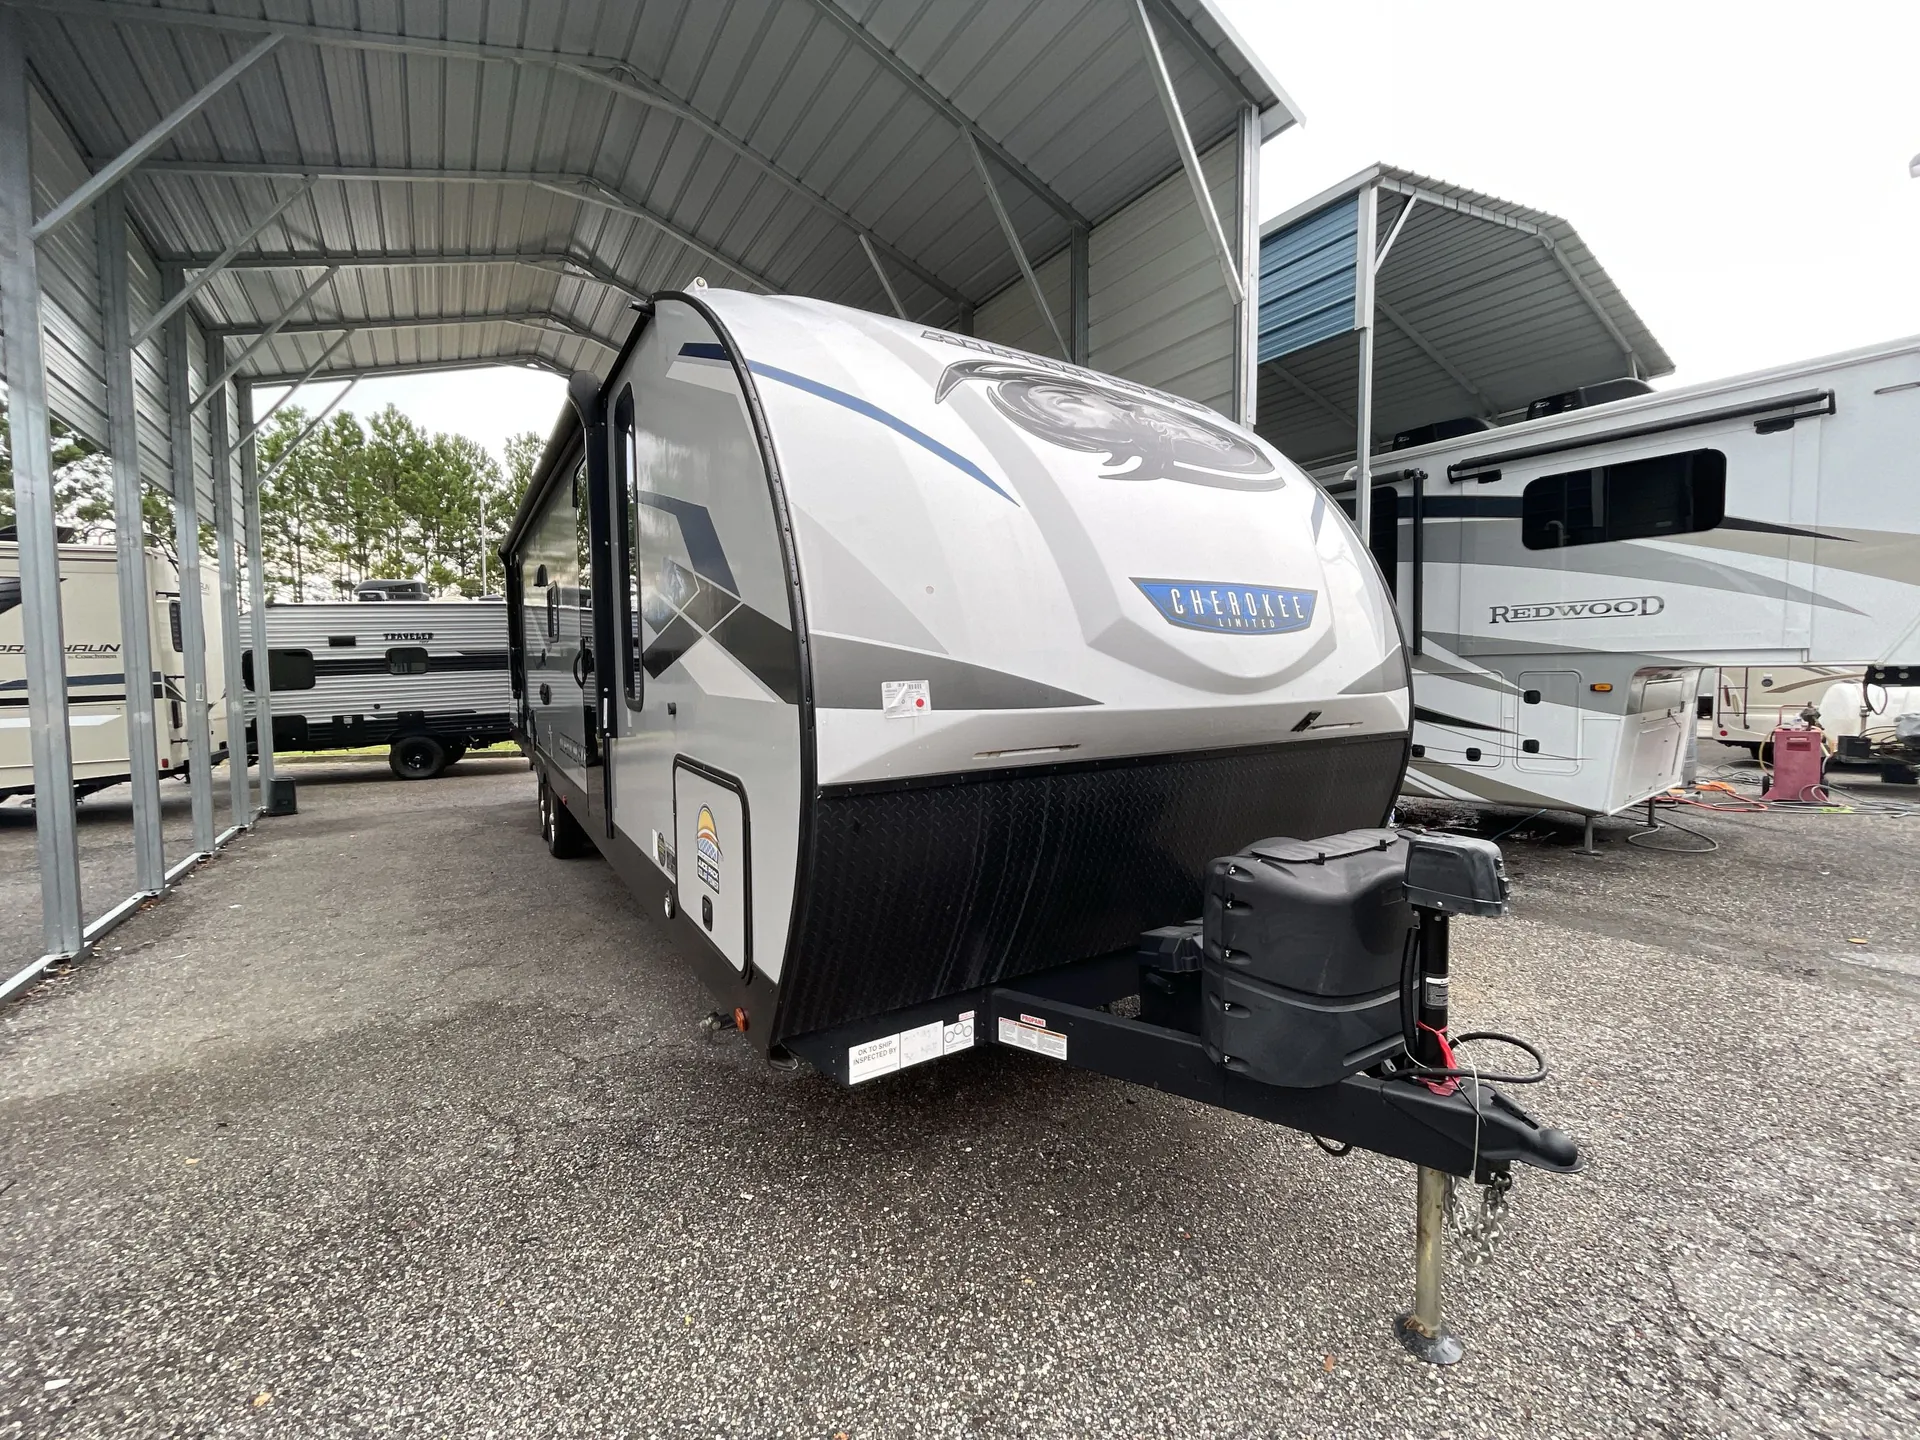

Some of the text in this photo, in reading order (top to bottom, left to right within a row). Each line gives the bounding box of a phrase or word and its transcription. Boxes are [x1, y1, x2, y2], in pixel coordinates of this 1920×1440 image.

[920, 330, 1100, 382] ALPHA
[1170, 588, 1305, 619] CHEROKEE
[1489, 595, 1665, 624] REDWOOD
[1218, 617, 1276, 628] LIMITED
[383, 633, 434, 641] TRAVELER
[1021, 1014, 1045, 1026] PROPANE
[853, 1046, 897, 1066] INSPECTED BY
[857, 1040, 893, 1056] OK TO SHIP
